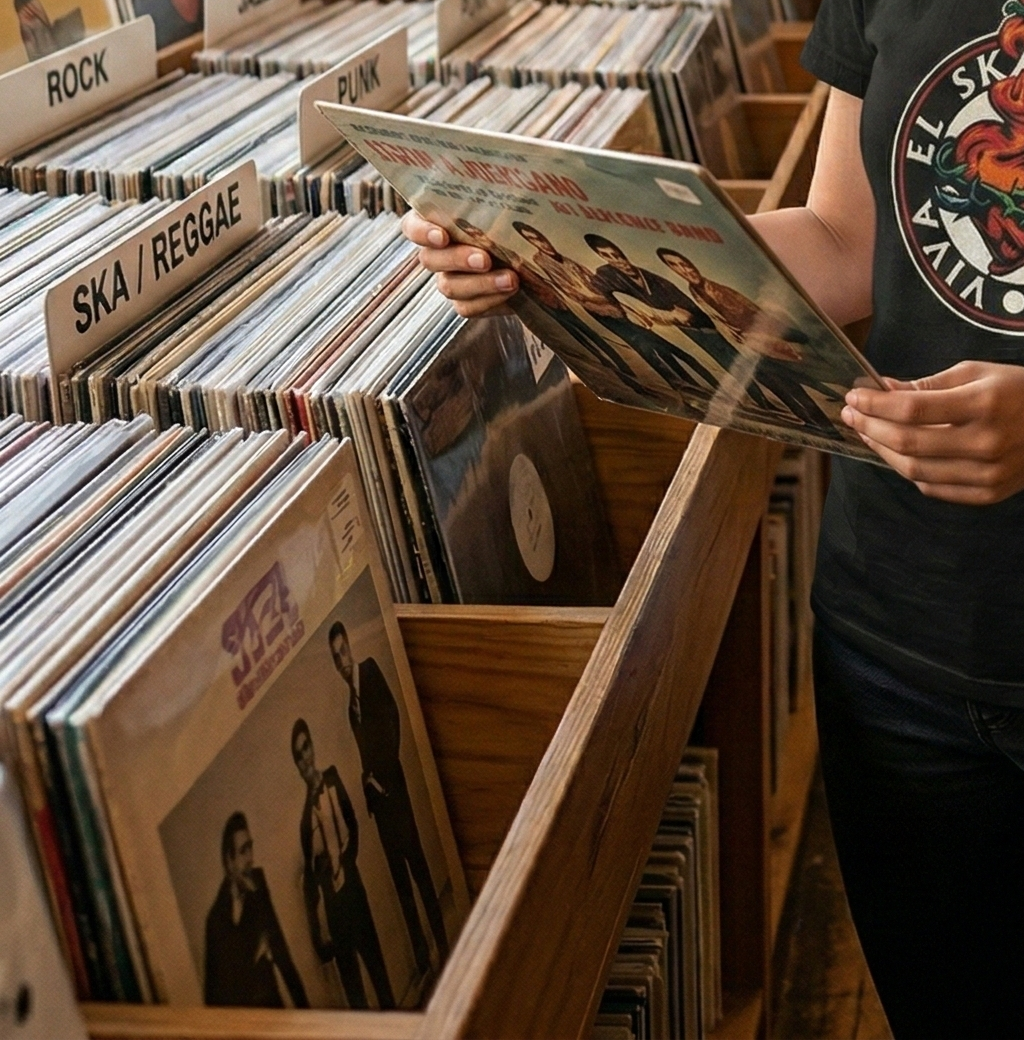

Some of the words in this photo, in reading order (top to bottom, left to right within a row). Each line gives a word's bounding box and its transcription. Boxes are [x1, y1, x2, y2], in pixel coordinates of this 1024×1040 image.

[47, 48, 109, 107] ROCK
[337, 53, 381, 105] PUNK
[906, 115, 944, 166] EL
[72, 259, 130, 334] SKA
[151, 181, 242, 282] REGGAE
[912, 198, 985, 310] VIVA
